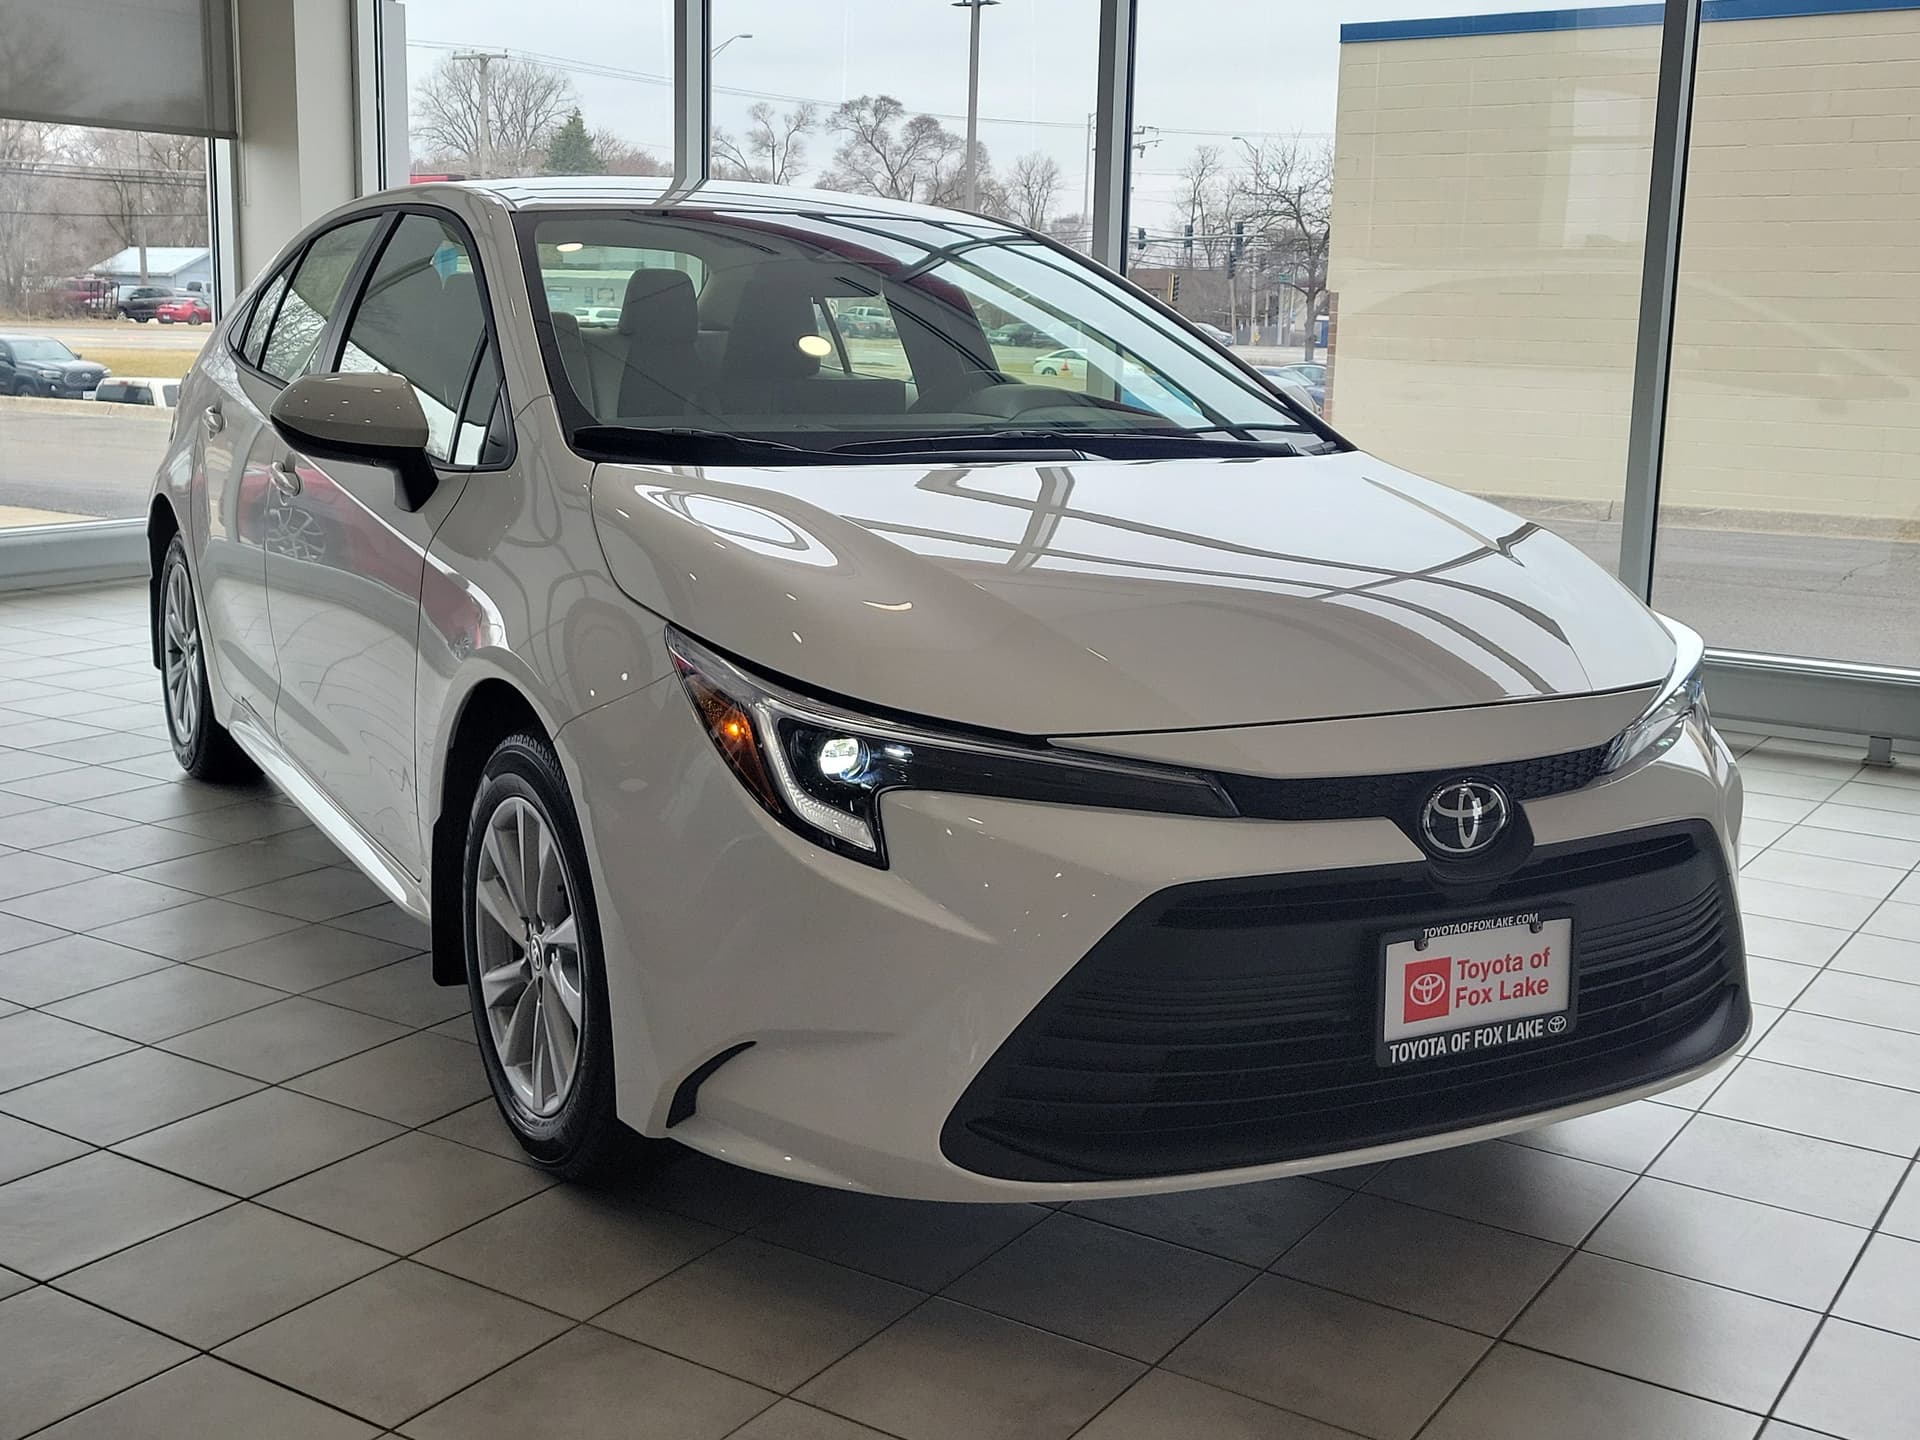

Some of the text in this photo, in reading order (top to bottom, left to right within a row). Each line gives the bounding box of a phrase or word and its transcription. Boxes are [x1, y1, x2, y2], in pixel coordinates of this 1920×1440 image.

[1423, 913, 1539, 939] TOYOTAOFFOXLAKE.COM
[1457, 947, 1551, 983] Toyota of
[1455, 976, 1550, 1009] Fox Lake
[1390, 1018, 1544, 1064] TOYOTA OF FOX LAKE
